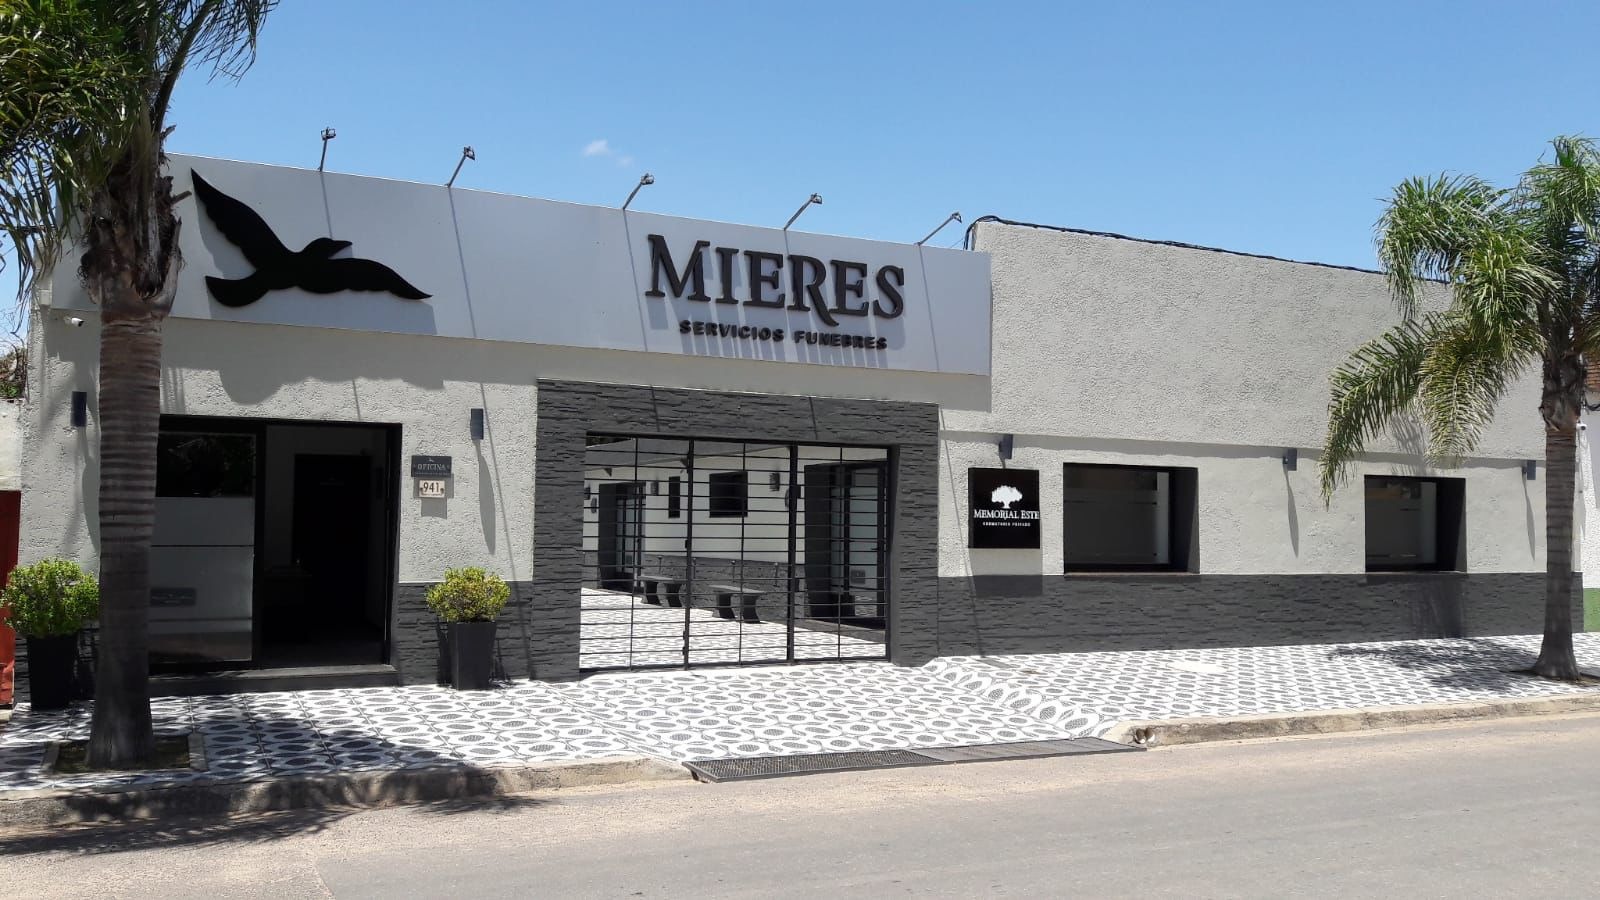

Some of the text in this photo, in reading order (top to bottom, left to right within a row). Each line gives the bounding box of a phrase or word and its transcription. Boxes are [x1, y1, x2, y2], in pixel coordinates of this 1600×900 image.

[645, 233, 905, 327] MIERES
[679, 319, 888, 350] SERVICIOS FUNEBRES
[423, 481, 440, 493] 941
[974, 509, 1019, 520] MEMORIAL
